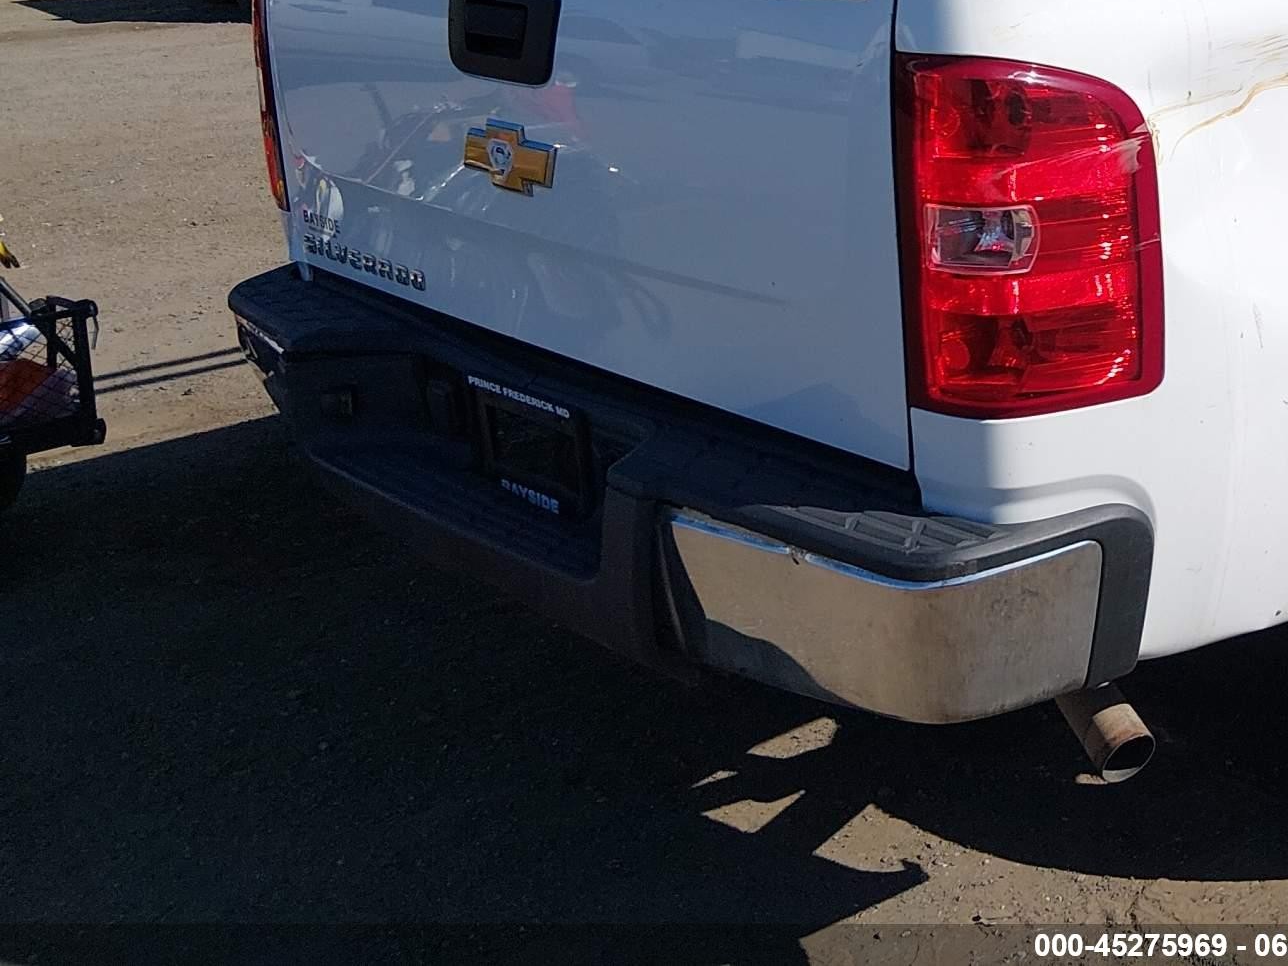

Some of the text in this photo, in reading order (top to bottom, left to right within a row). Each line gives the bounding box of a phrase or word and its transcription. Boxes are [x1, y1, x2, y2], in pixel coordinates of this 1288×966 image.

[303, 209, 341, 234] BAYSIDE
[303, 233, 426, 291] SILVERADO
[467, 375, 571, 419] PRINCE FREDERICK MD
[501, 478, 559, 514] BAYSIDE
